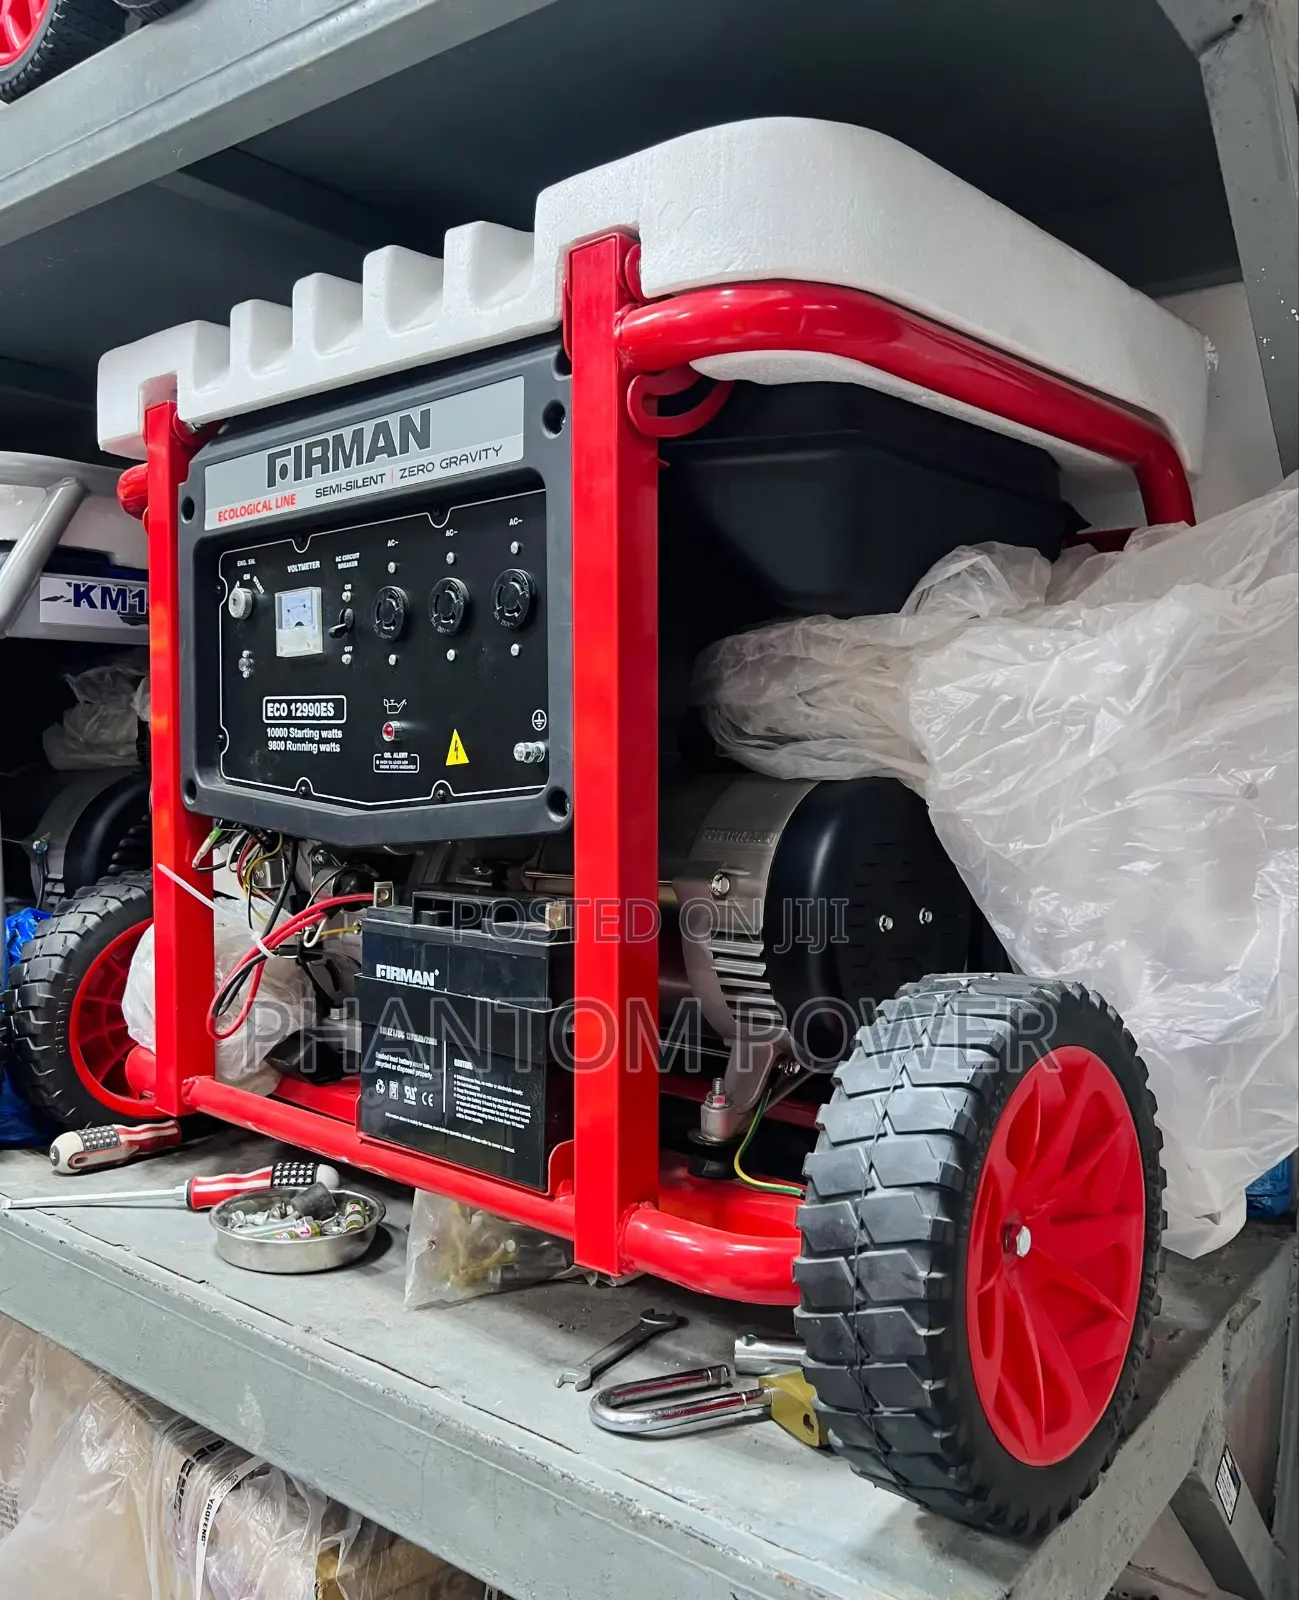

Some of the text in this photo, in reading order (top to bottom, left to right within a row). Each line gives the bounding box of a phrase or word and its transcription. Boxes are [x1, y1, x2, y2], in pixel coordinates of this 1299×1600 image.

[267, 407, 431, 489] FIRMAN
[315, 445, 503, 498] SEMI-SILENT ZERO GRAVITY
[217, 494, 296, 522] ECOLOGICAL LINE
[287, 560, 320, 573] VOLTMETER
[73, 583, 147, 614] KM1
[267, 702, 335, 717] ECO 12990ES
[267, 727, 343, 741] 10000 Starting watts
[268, 740, 341, 754] 9800 Running watts
